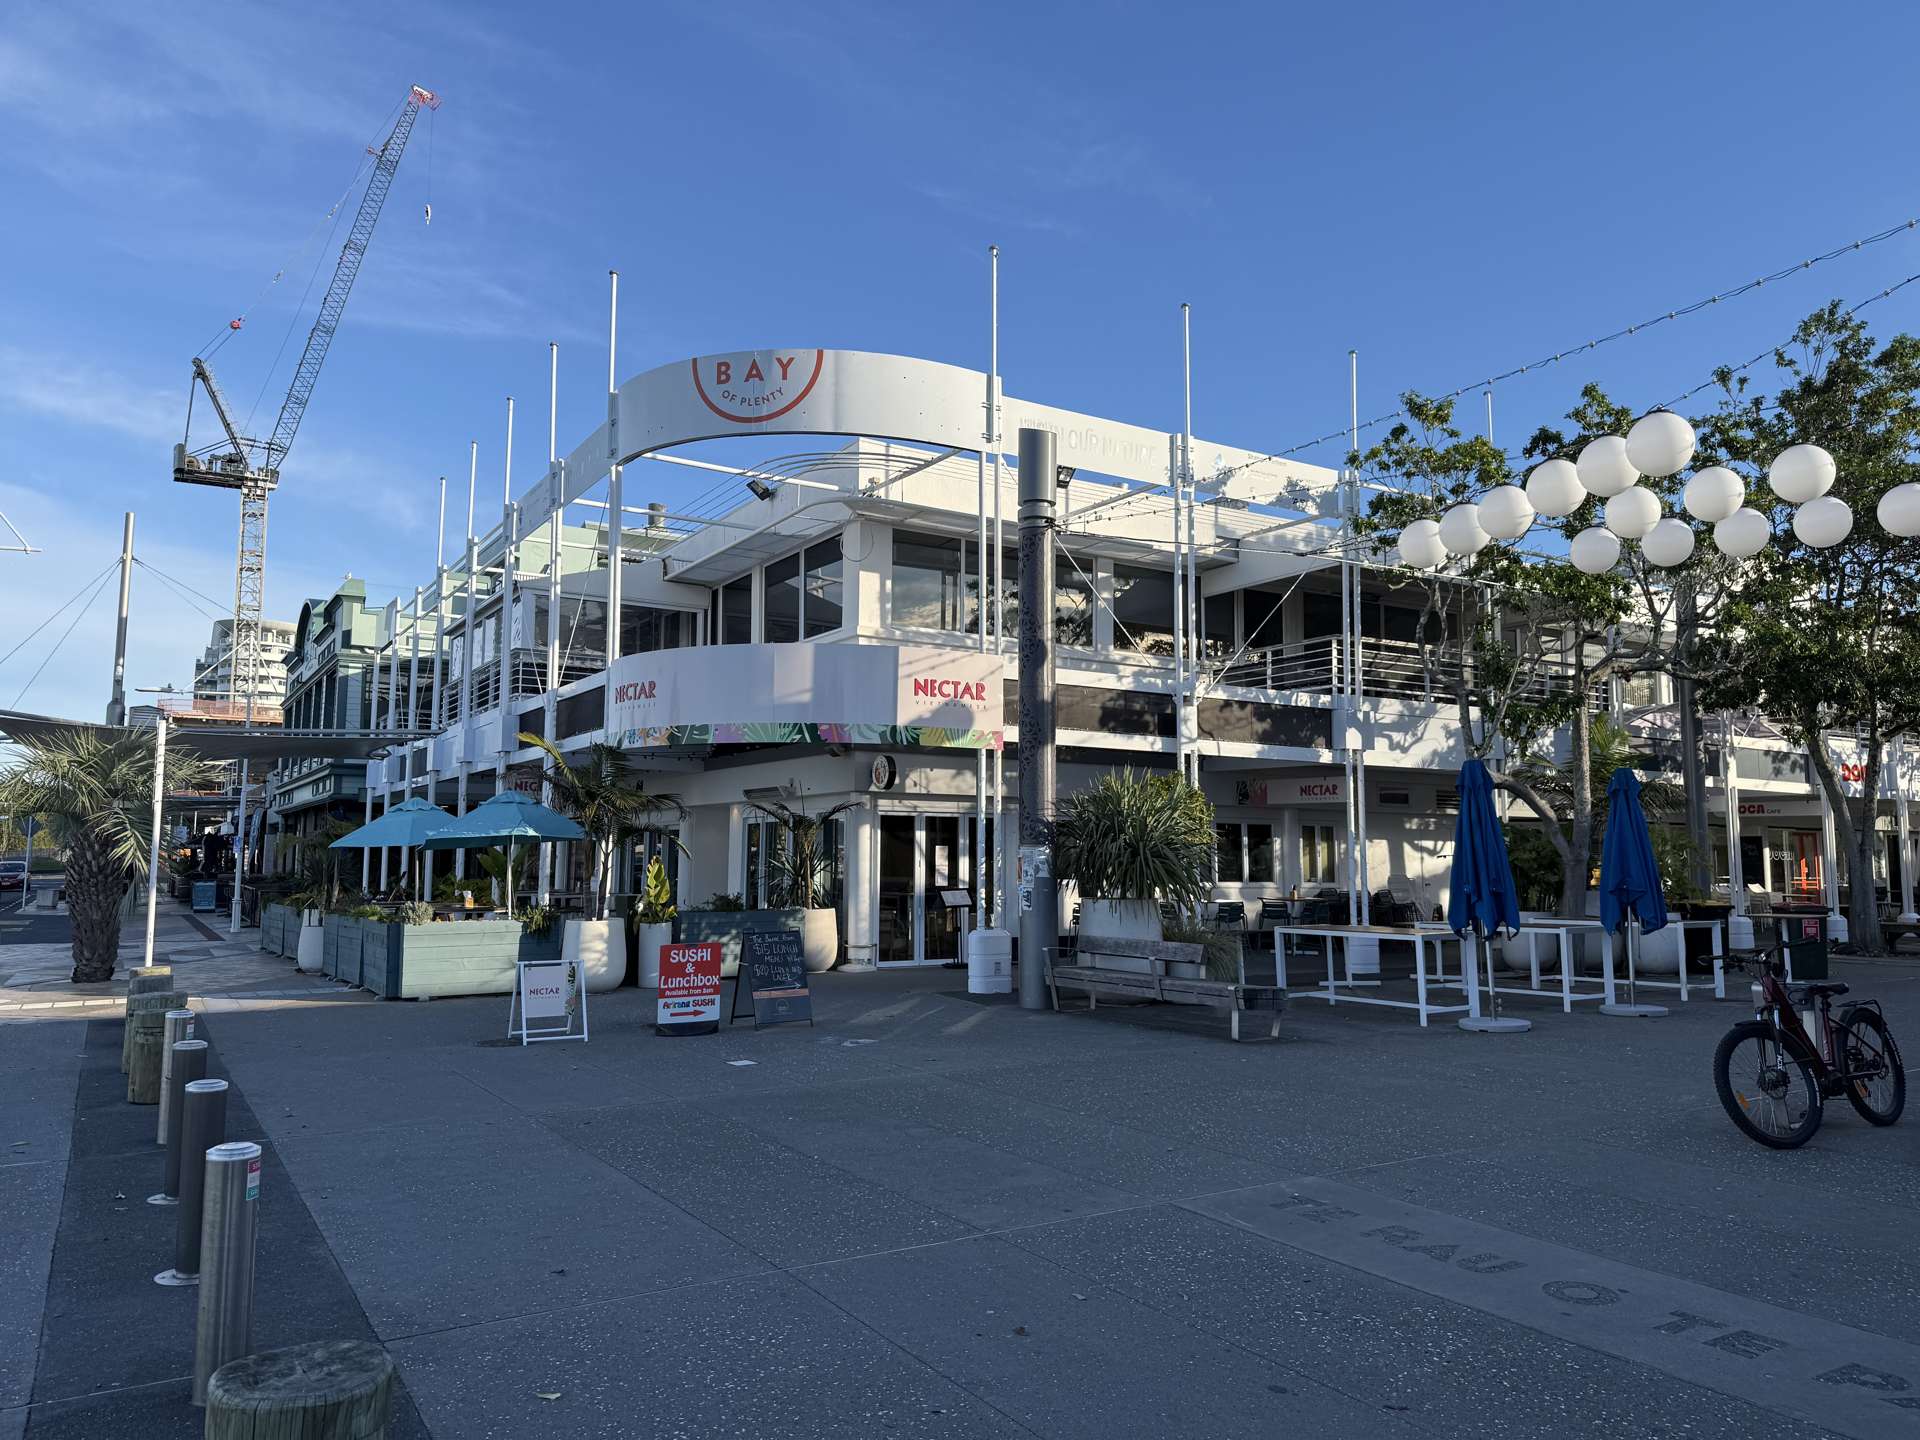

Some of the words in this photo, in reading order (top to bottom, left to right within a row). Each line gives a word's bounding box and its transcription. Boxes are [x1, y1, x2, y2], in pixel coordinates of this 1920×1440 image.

[716, 357, 795, 385] BAY
[721, 390, 738, 402] OF
[740, 387, 784, 407] PLENTY
[615, 681, 656, 704] NECTAR
[914, 678, 986, 701] NECTAR
[1300, 784, 1338, 796] NECTAR
[670, 948, 711, 963] SUSHI
[685, 962, 696, 973] &
[660, 974, 719, 989] Lunchbox
[529, 987, 560, 996] NECTAR
[691, 998, 716, 1008] SUSHI
[1359, 1223, 1529, 1275] RAU
[1652, 1309, 1789, 1360] TE
